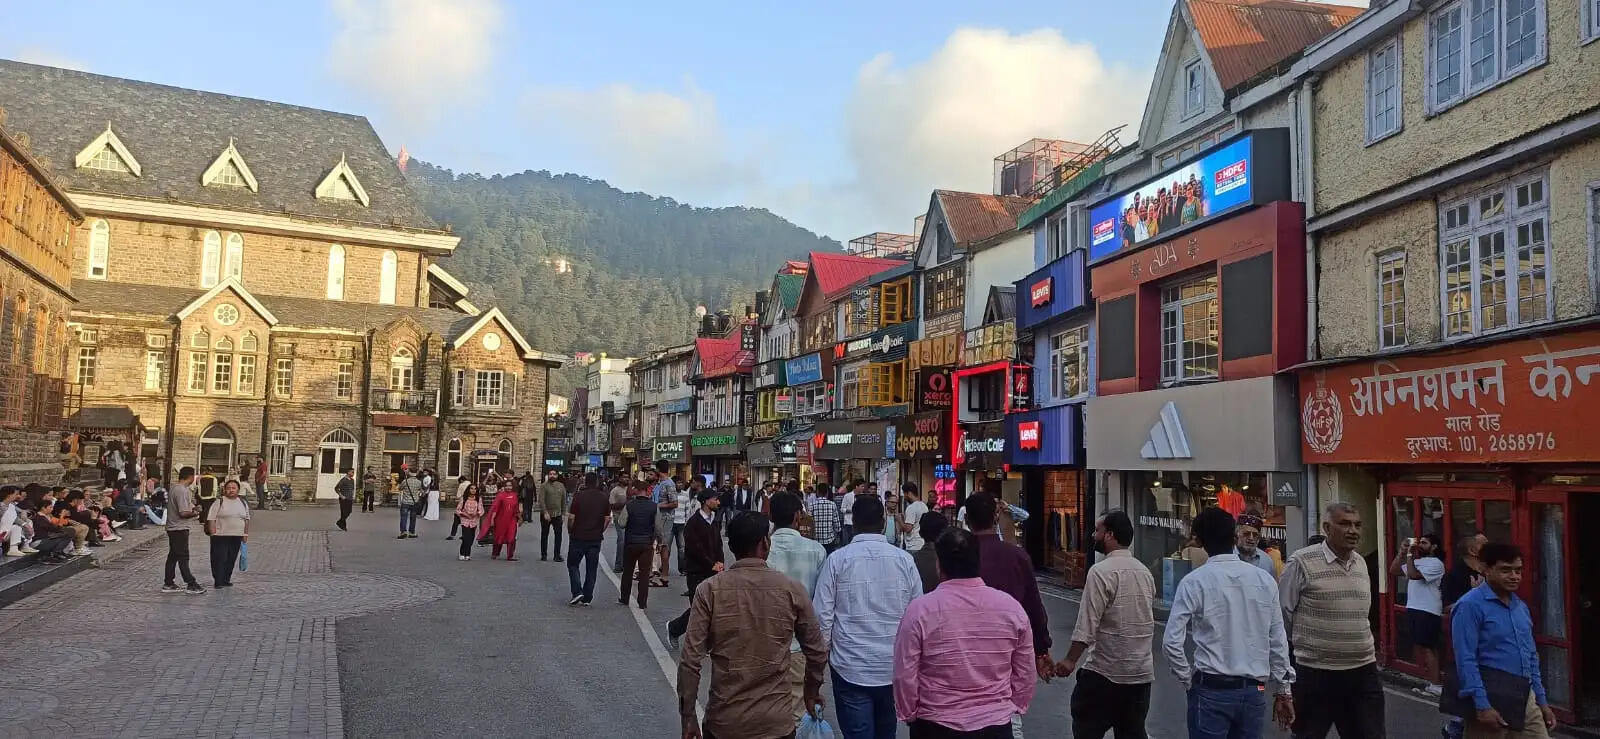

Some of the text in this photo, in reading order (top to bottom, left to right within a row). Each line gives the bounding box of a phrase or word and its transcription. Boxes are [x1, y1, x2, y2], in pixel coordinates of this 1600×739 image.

[1222, 162, 1245, 179] HDFC
[1149, 242, 1177, 273] ADA
[924, 391, 951, 400] xero
[1349, 360, 1507, 417] अग्निशमन
[924, 399, 951, 407] degrees
[914, 417, 939, 434] xero
[1444, 408, 1501, 432] माल रोड
[656, 441, 684, 452] OCTAVE
[827, 433, 853, 445] WILDCRAFT
[897, 433, 939, 458] degrees
[1490, 433, 1555, 452] 2658976
[1140, 515, 1184, 529] ADIDAS WALKING
